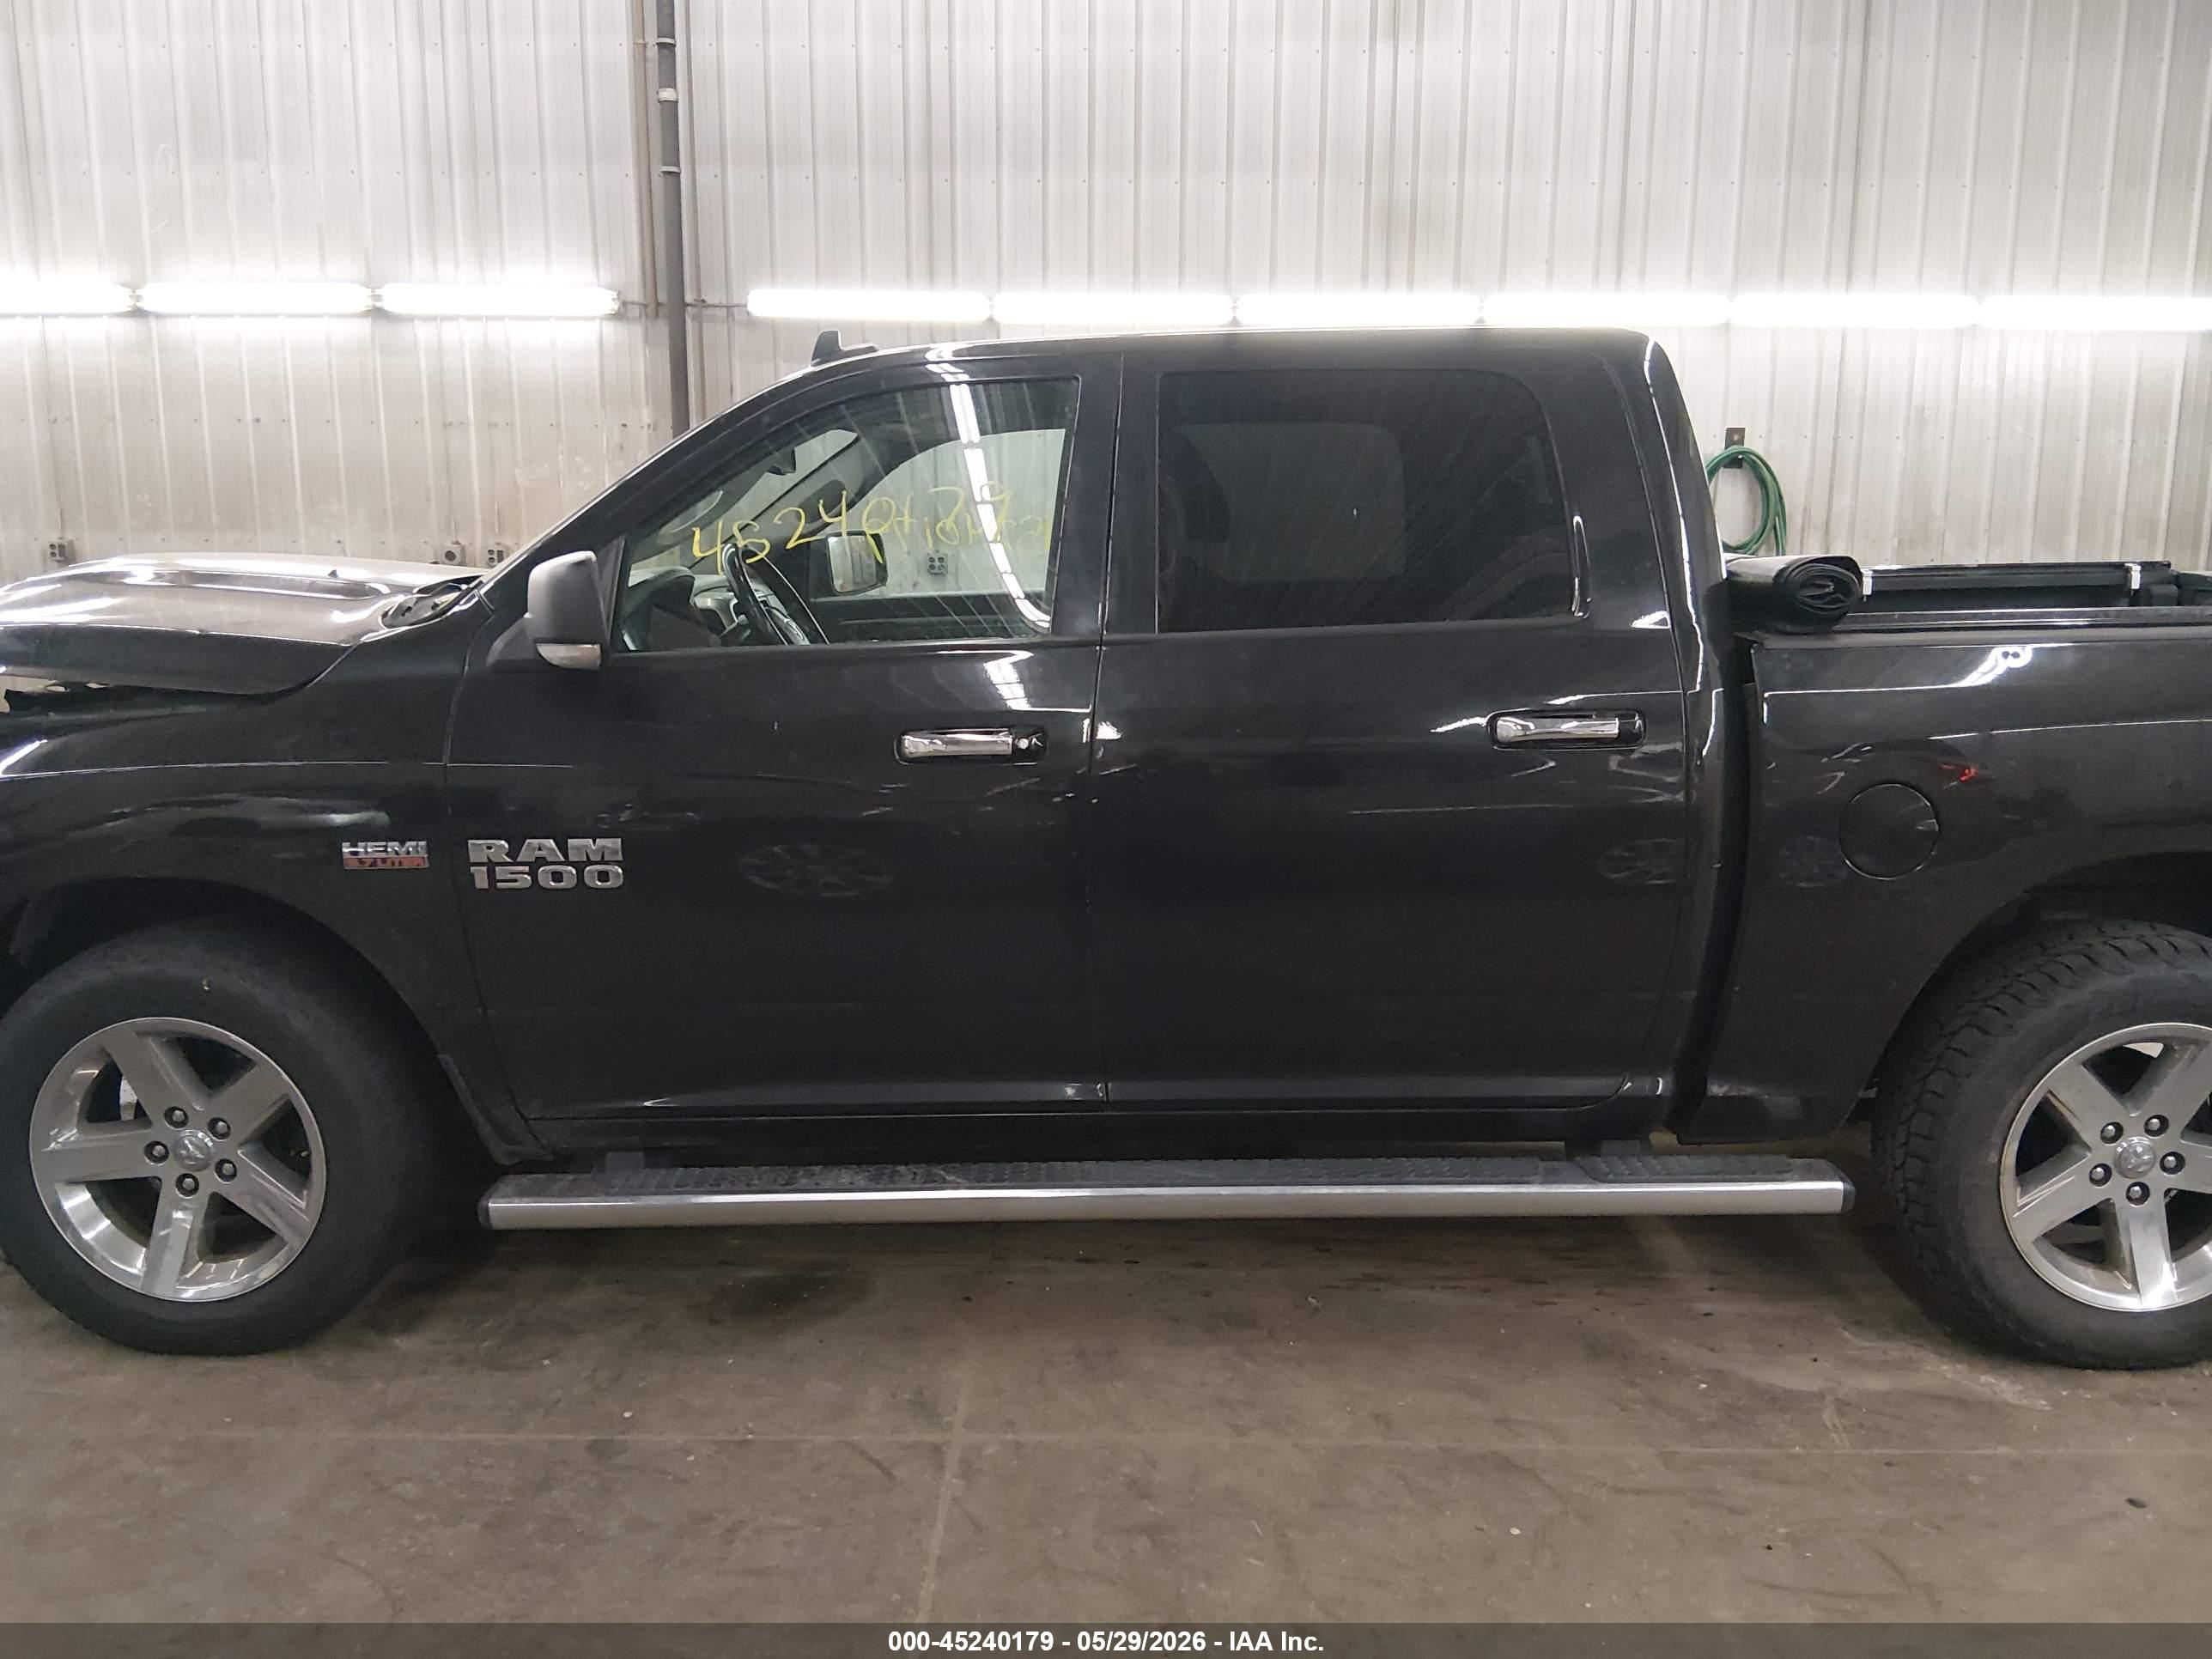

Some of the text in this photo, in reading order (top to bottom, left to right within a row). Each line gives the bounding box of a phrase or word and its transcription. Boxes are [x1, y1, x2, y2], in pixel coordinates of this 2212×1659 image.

[691, 480, 1012, 575] 45240179
[342, 841, 427, 857] HEMI
[467, 837, 623, 863] RAM
[470, 864, 624, 889] 1500
